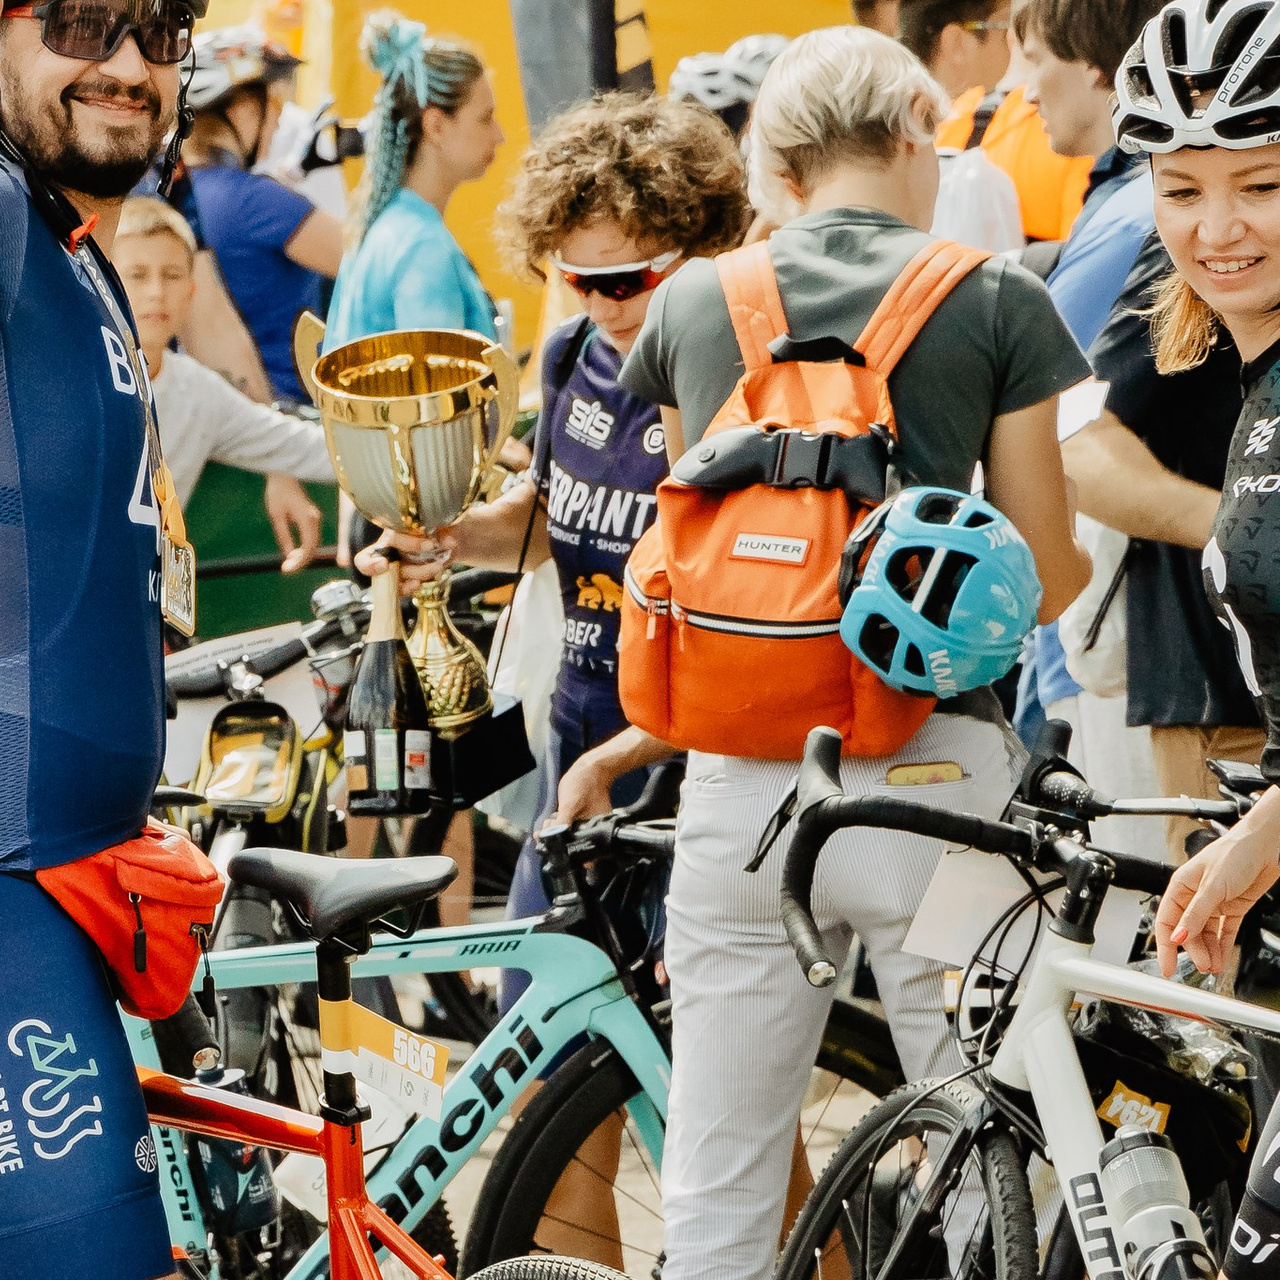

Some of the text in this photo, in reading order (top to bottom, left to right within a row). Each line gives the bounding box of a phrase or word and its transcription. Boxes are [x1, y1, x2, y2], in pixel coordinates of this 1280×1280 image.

[736, 539, 804, 557] HUNTER
[460, 940, 521, 956] ARIA
[393, 1028, 436, 1080] 566
